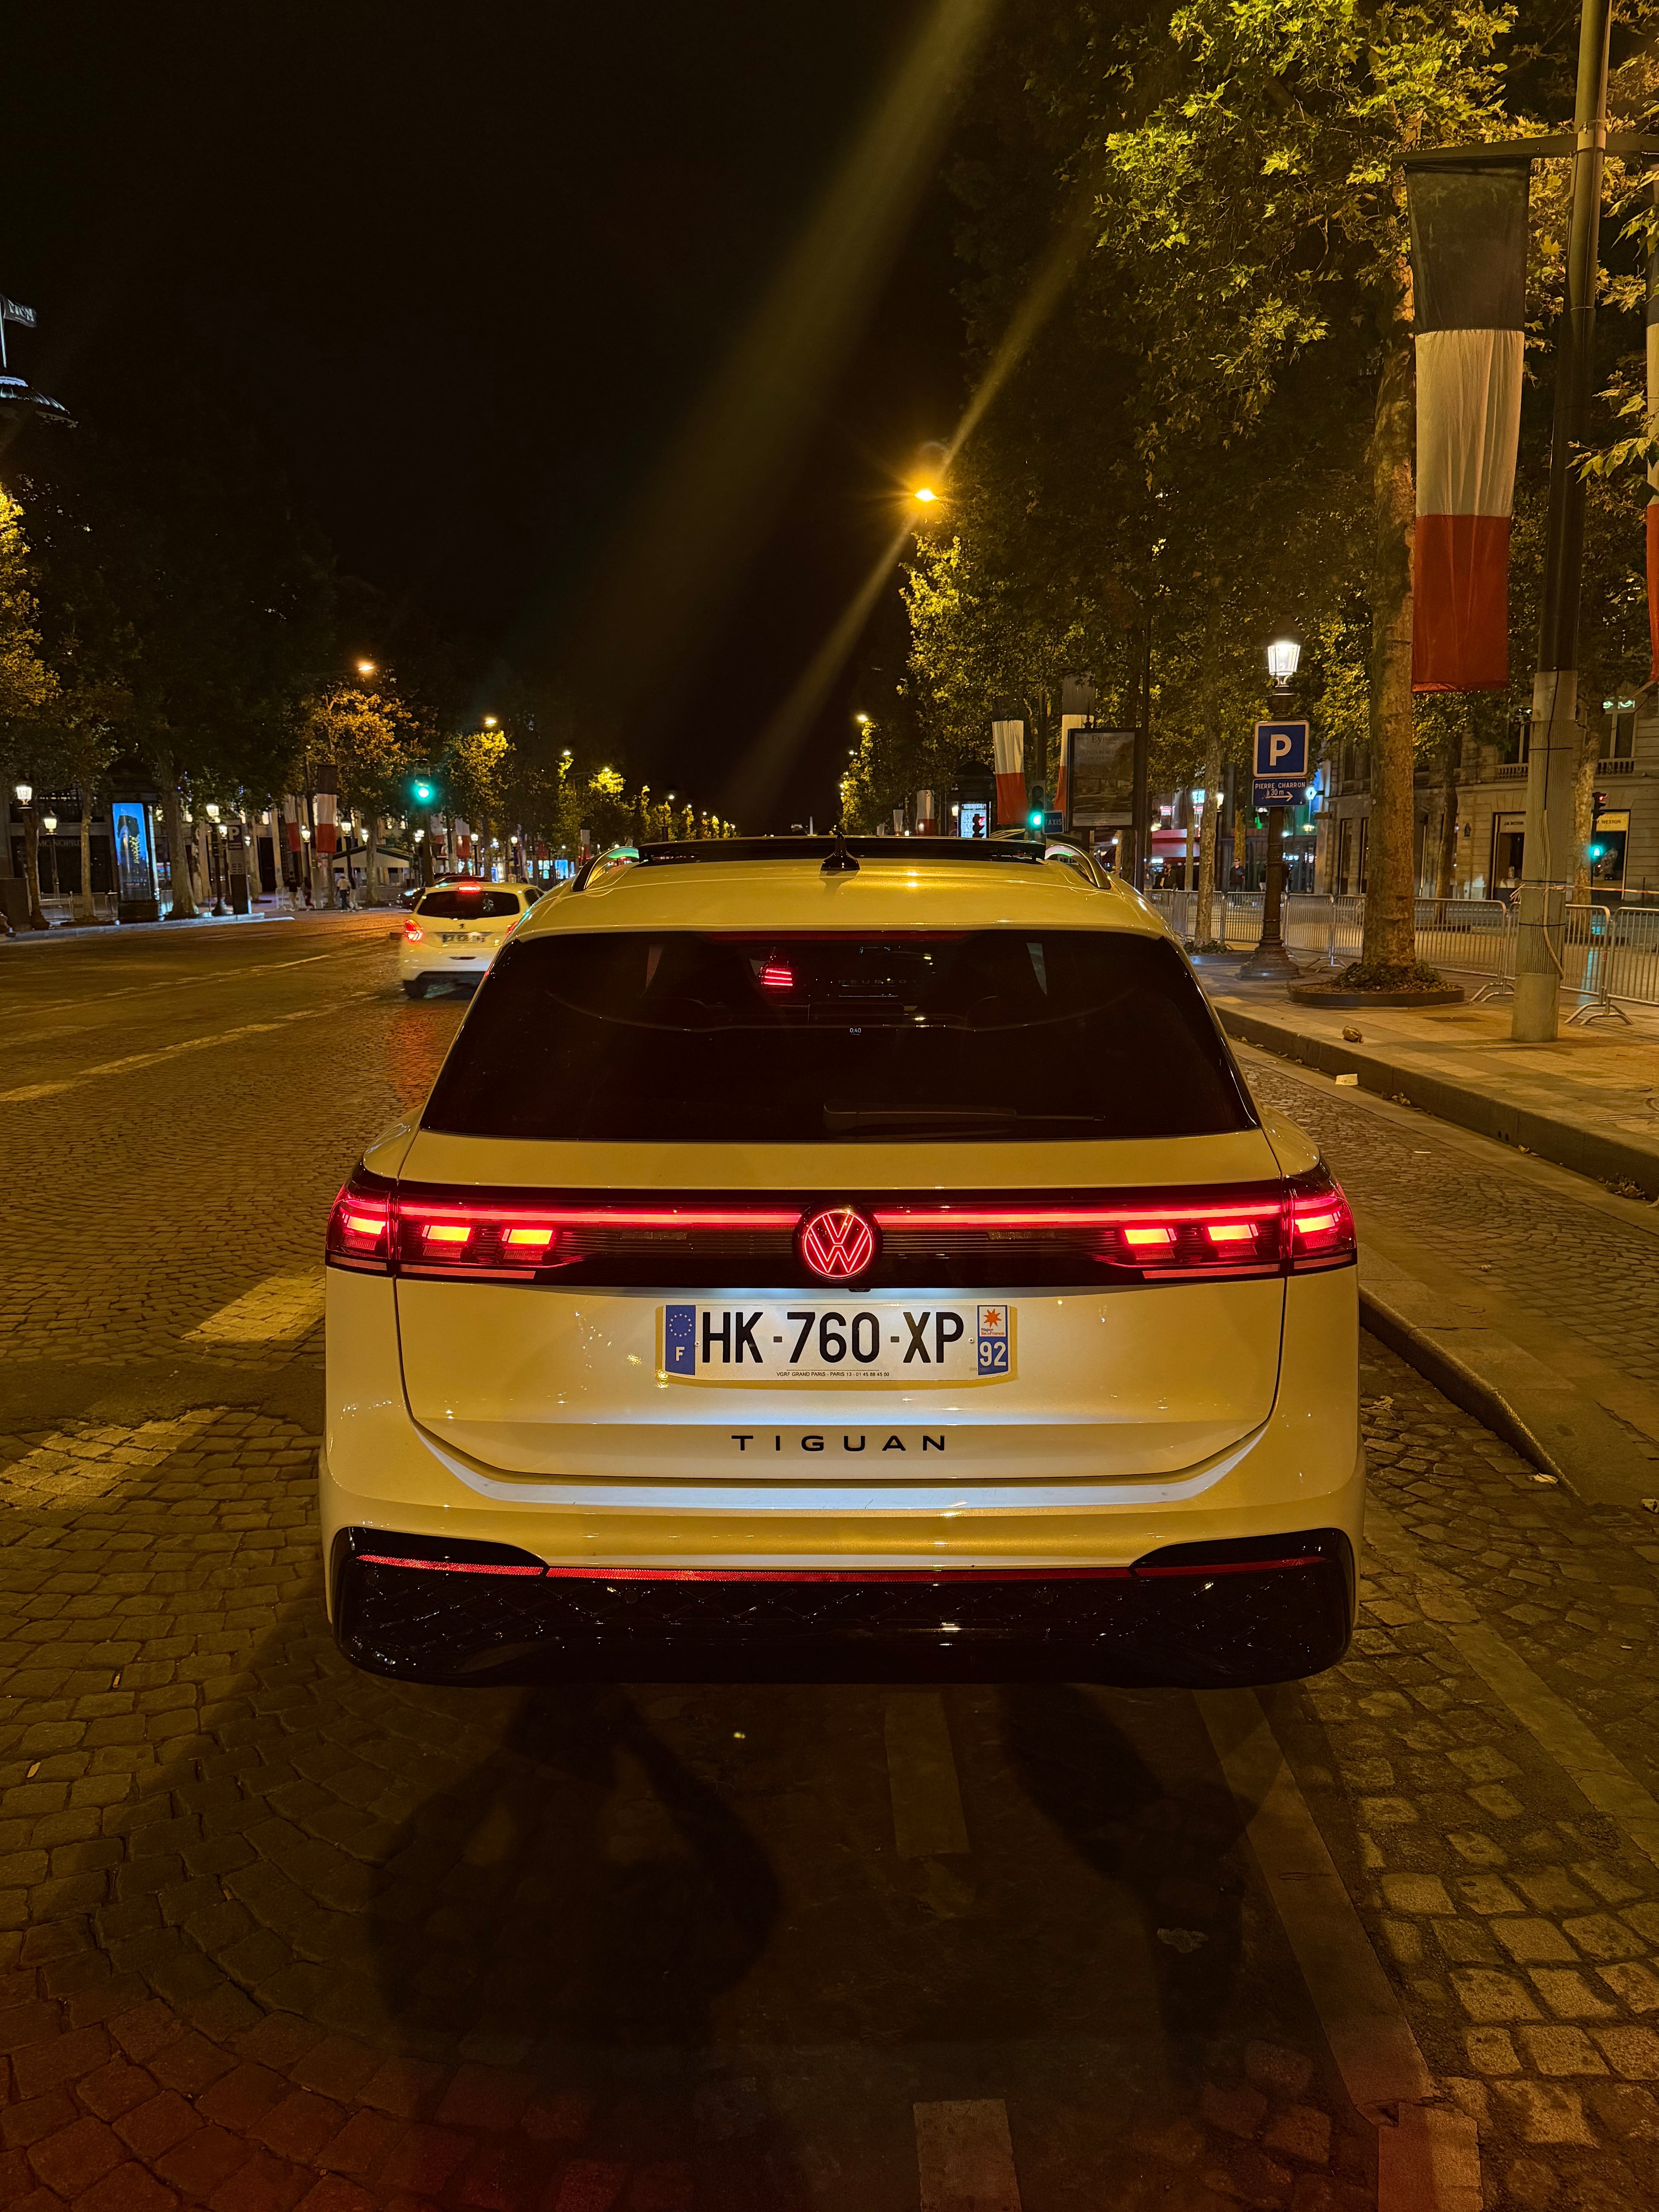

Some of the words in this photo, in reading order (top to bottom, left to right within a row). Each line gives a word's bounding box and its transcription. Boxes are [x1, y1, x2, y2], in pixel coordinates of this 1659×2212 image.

[1269, 734, 1292, 766] P
[228, 826, 240, 841] P
[675, 1348, 685, 1362] F
[980, 1341, 1006, 1366] 92
[731, 1435, 946, 1452] TIGUAN
